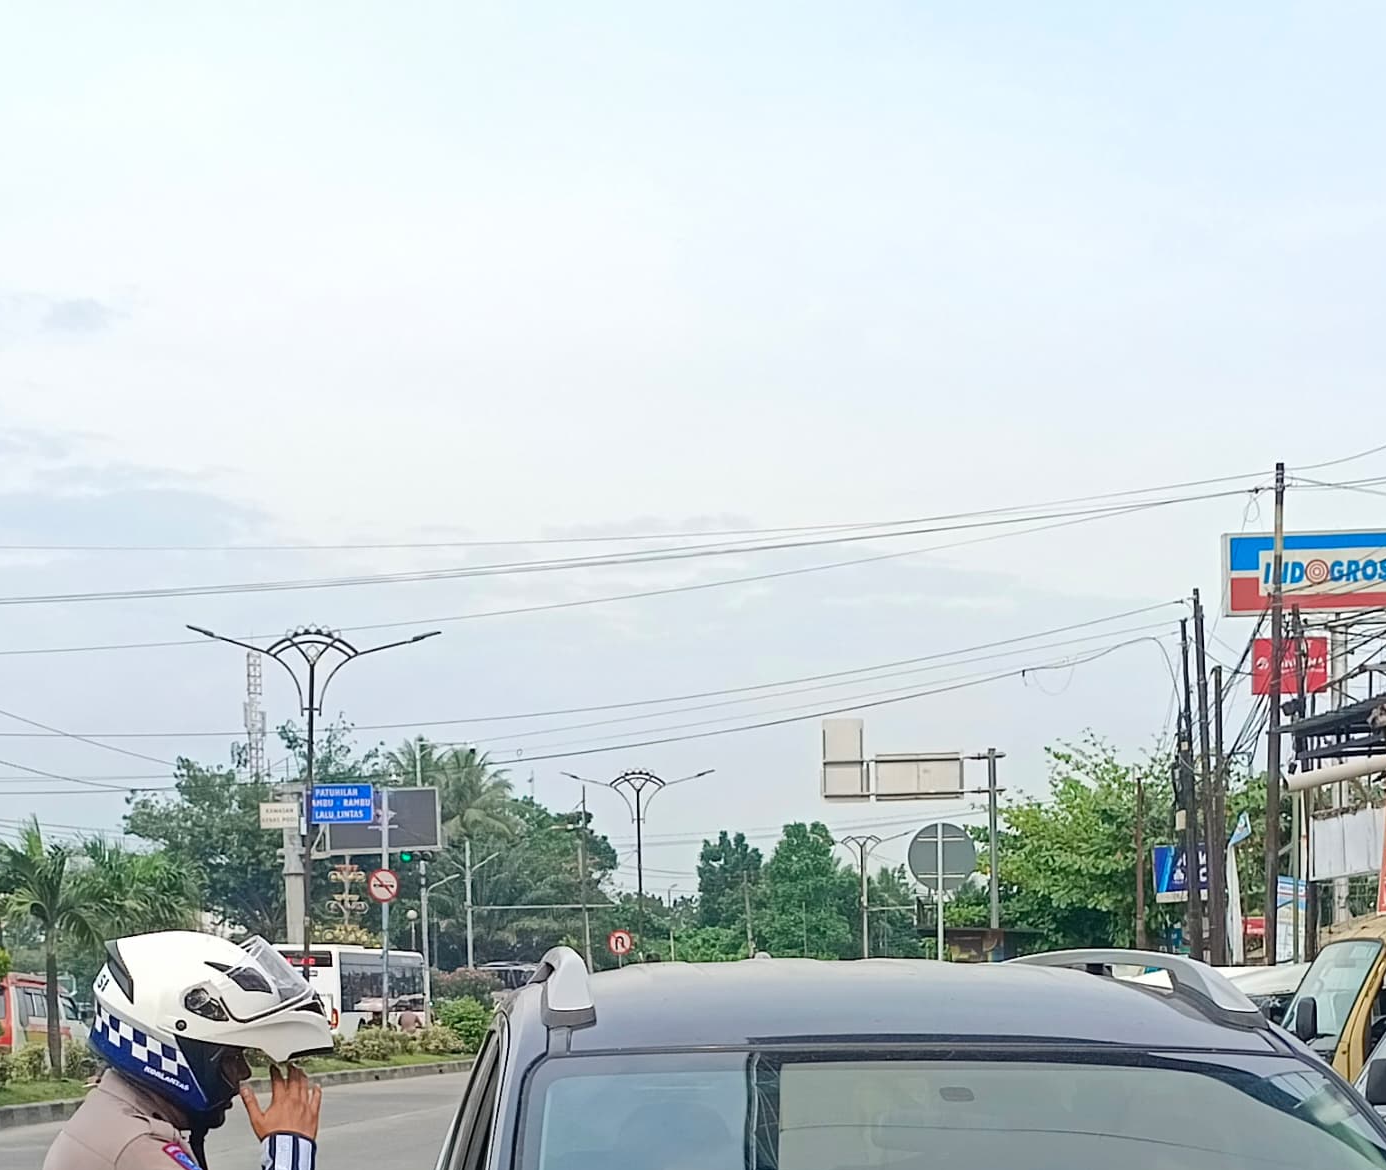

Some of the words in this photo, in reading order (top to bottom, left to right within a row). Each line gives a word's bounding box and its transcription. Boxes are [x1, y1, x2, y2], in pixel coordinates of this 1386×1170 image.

[343, 798, 371, 807] RAMBU
[315, 810, 334, 819] LALU
[337, 809, 364, 818] LINTAS
